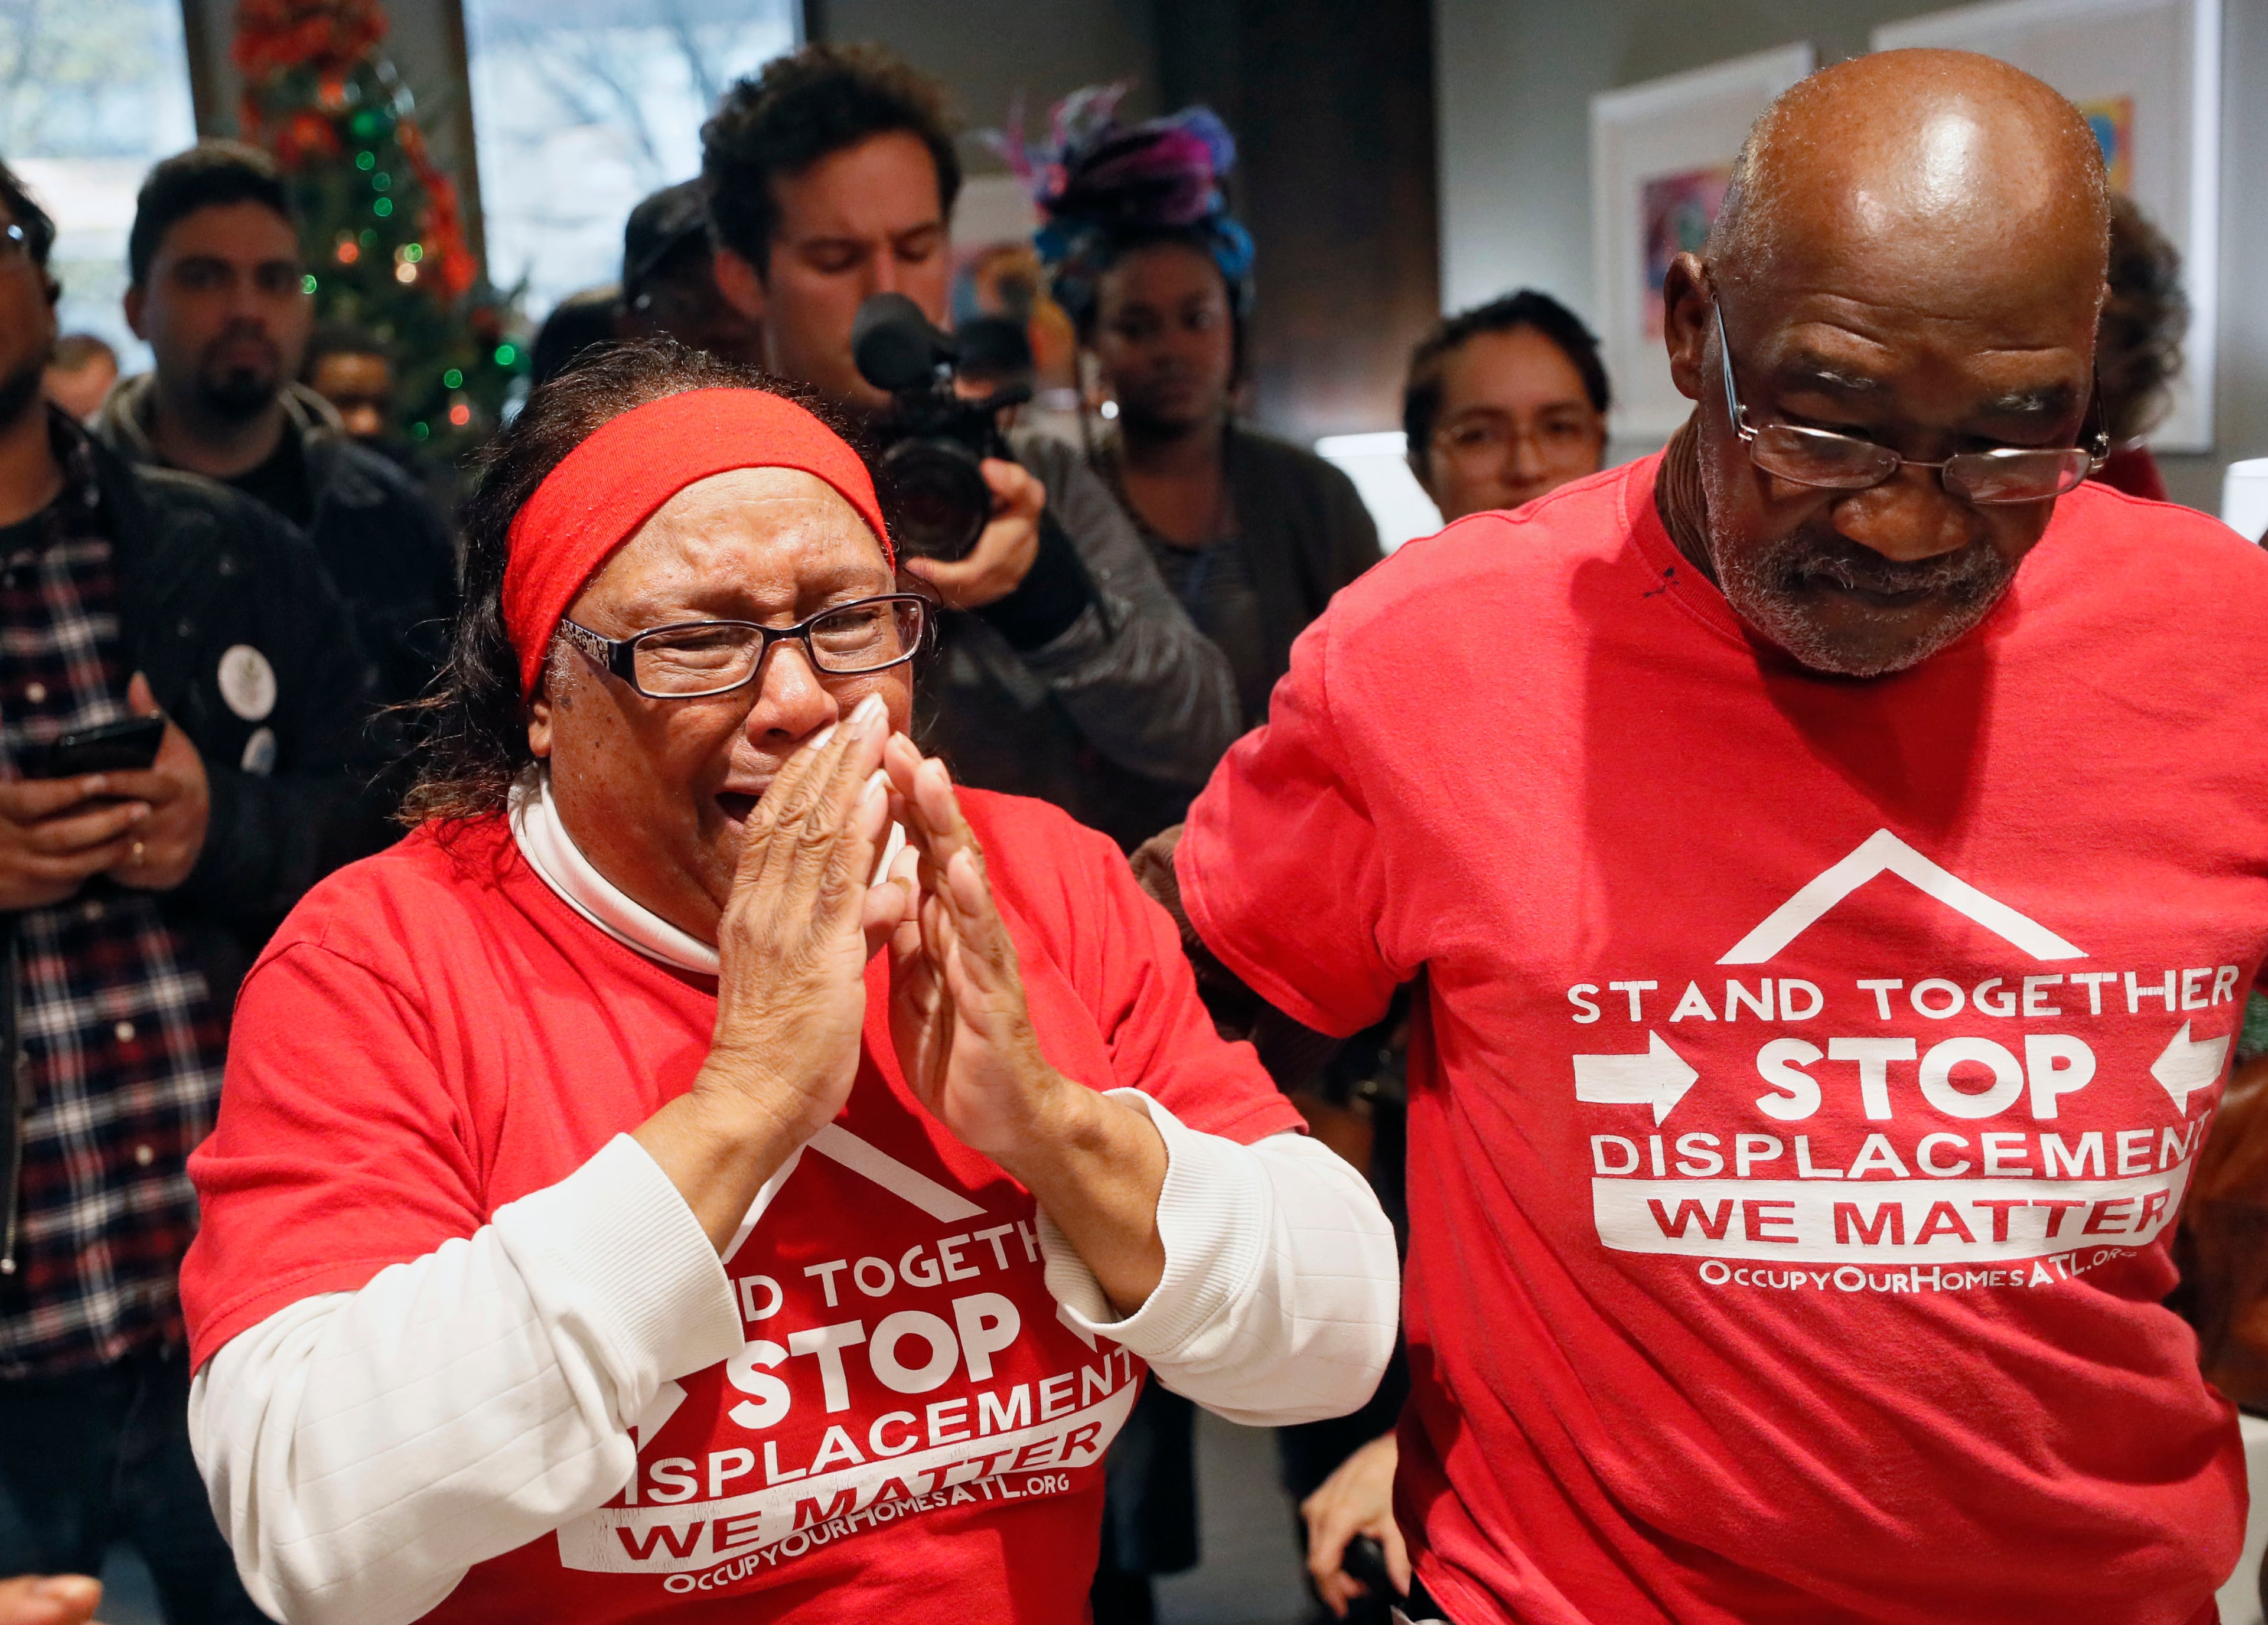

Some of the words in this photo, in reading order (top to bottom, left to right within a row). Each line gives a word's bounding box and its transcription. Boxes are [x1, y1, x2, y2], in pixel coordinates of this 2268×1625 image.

[1567, 977, 1824, 1024] STAND
[1856, 965, 2239, 1020] TOGETHER
[1755, 1033, 2097, 1120] STOP
[1591, 1109, 2211, 1179] DISPLACEMENT
[1646, 1198, 1799, 1245] WE
[1834, 1189, 2170, 1245] MATTER
[804, 1220, 1040, 1308] TOGETH
[726, 1293, 1021, 1430] STOP
[624, 1345, 1132, 1505] ISPLACEMENT
[615, 1511, 762, 1561] WE
[792, 1421, 1103, 1531] MATTER
